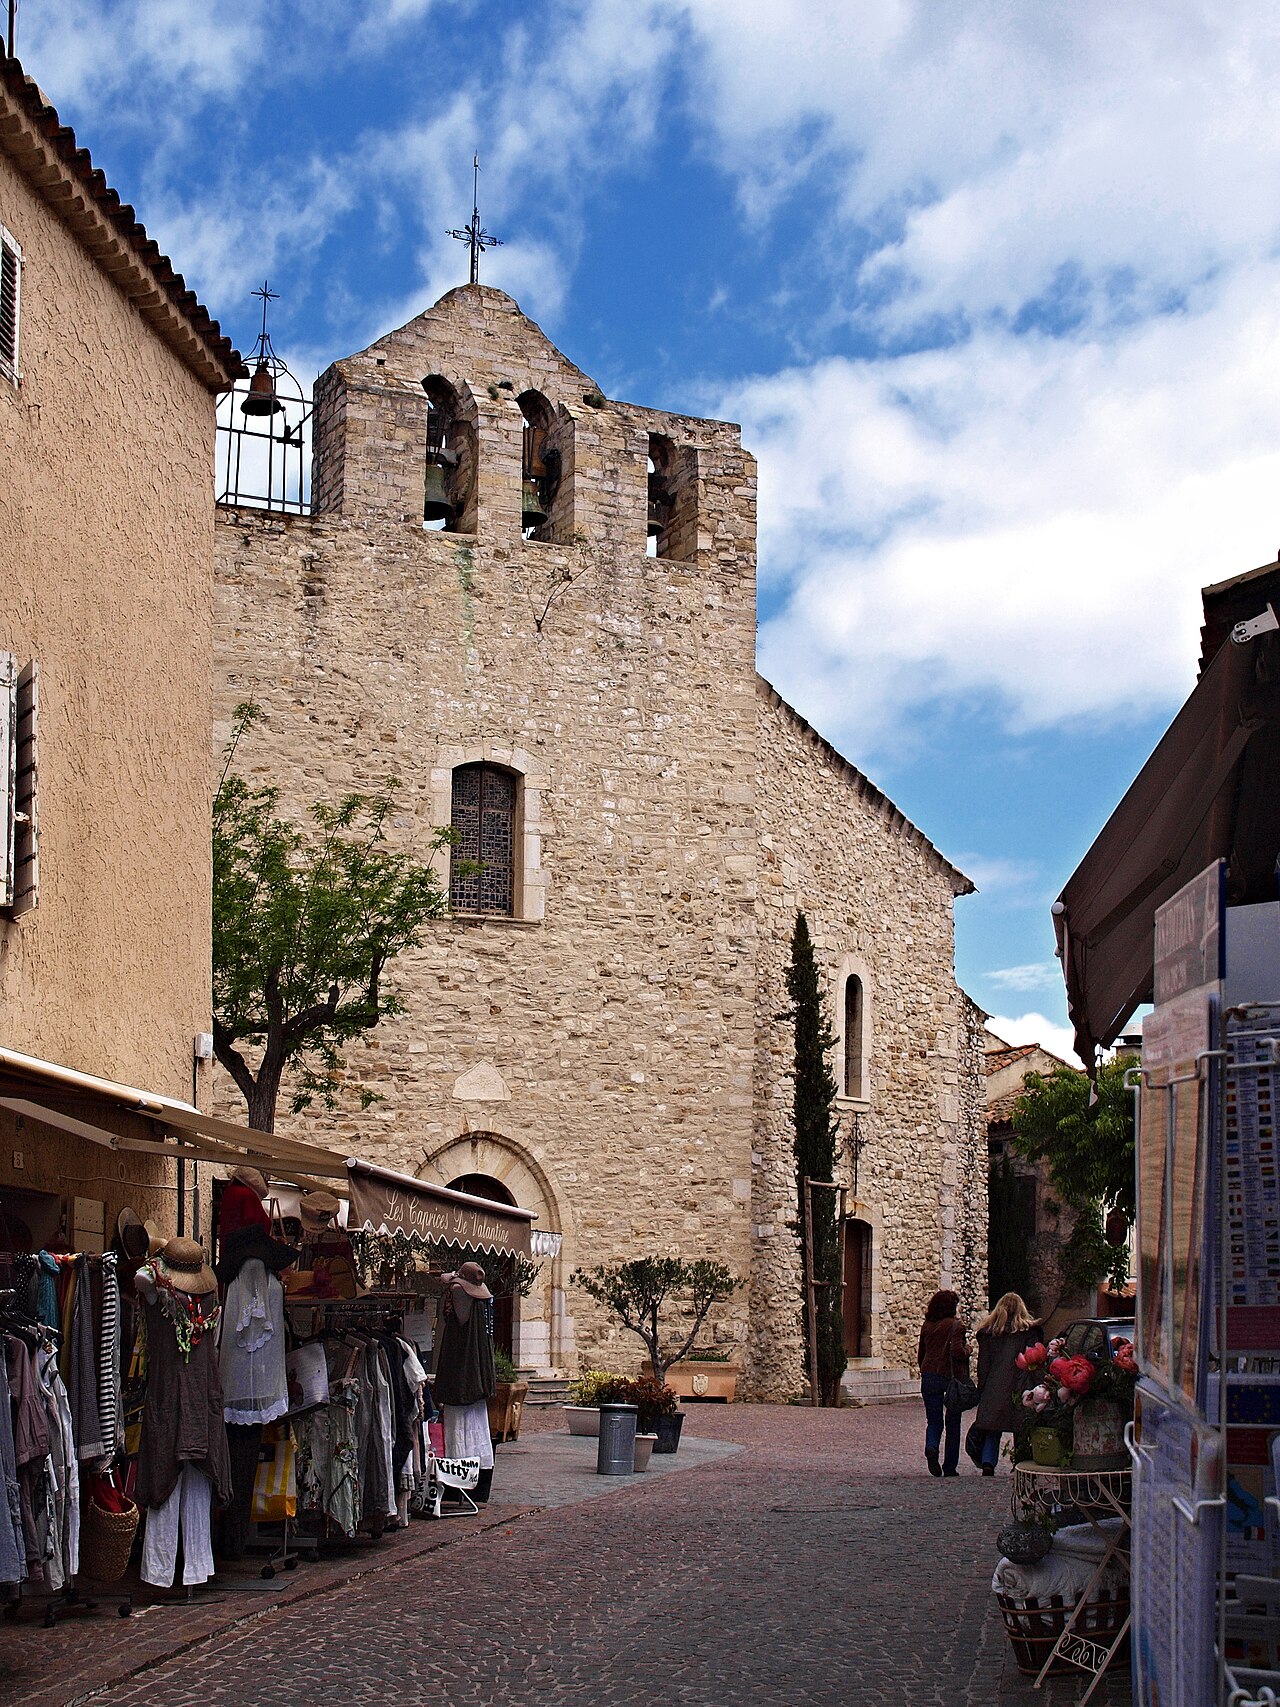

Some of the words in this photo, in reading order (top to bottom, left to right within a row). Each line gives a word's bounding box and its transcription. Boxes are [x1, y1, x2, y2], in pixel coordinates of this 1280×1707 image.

[383, 1187, 404, 1221] Les
[407, 1194, 449, 1231] Caprices
[453, 1205, 467, 1235] De
[436, 1459, 469, 1480] Kitty
